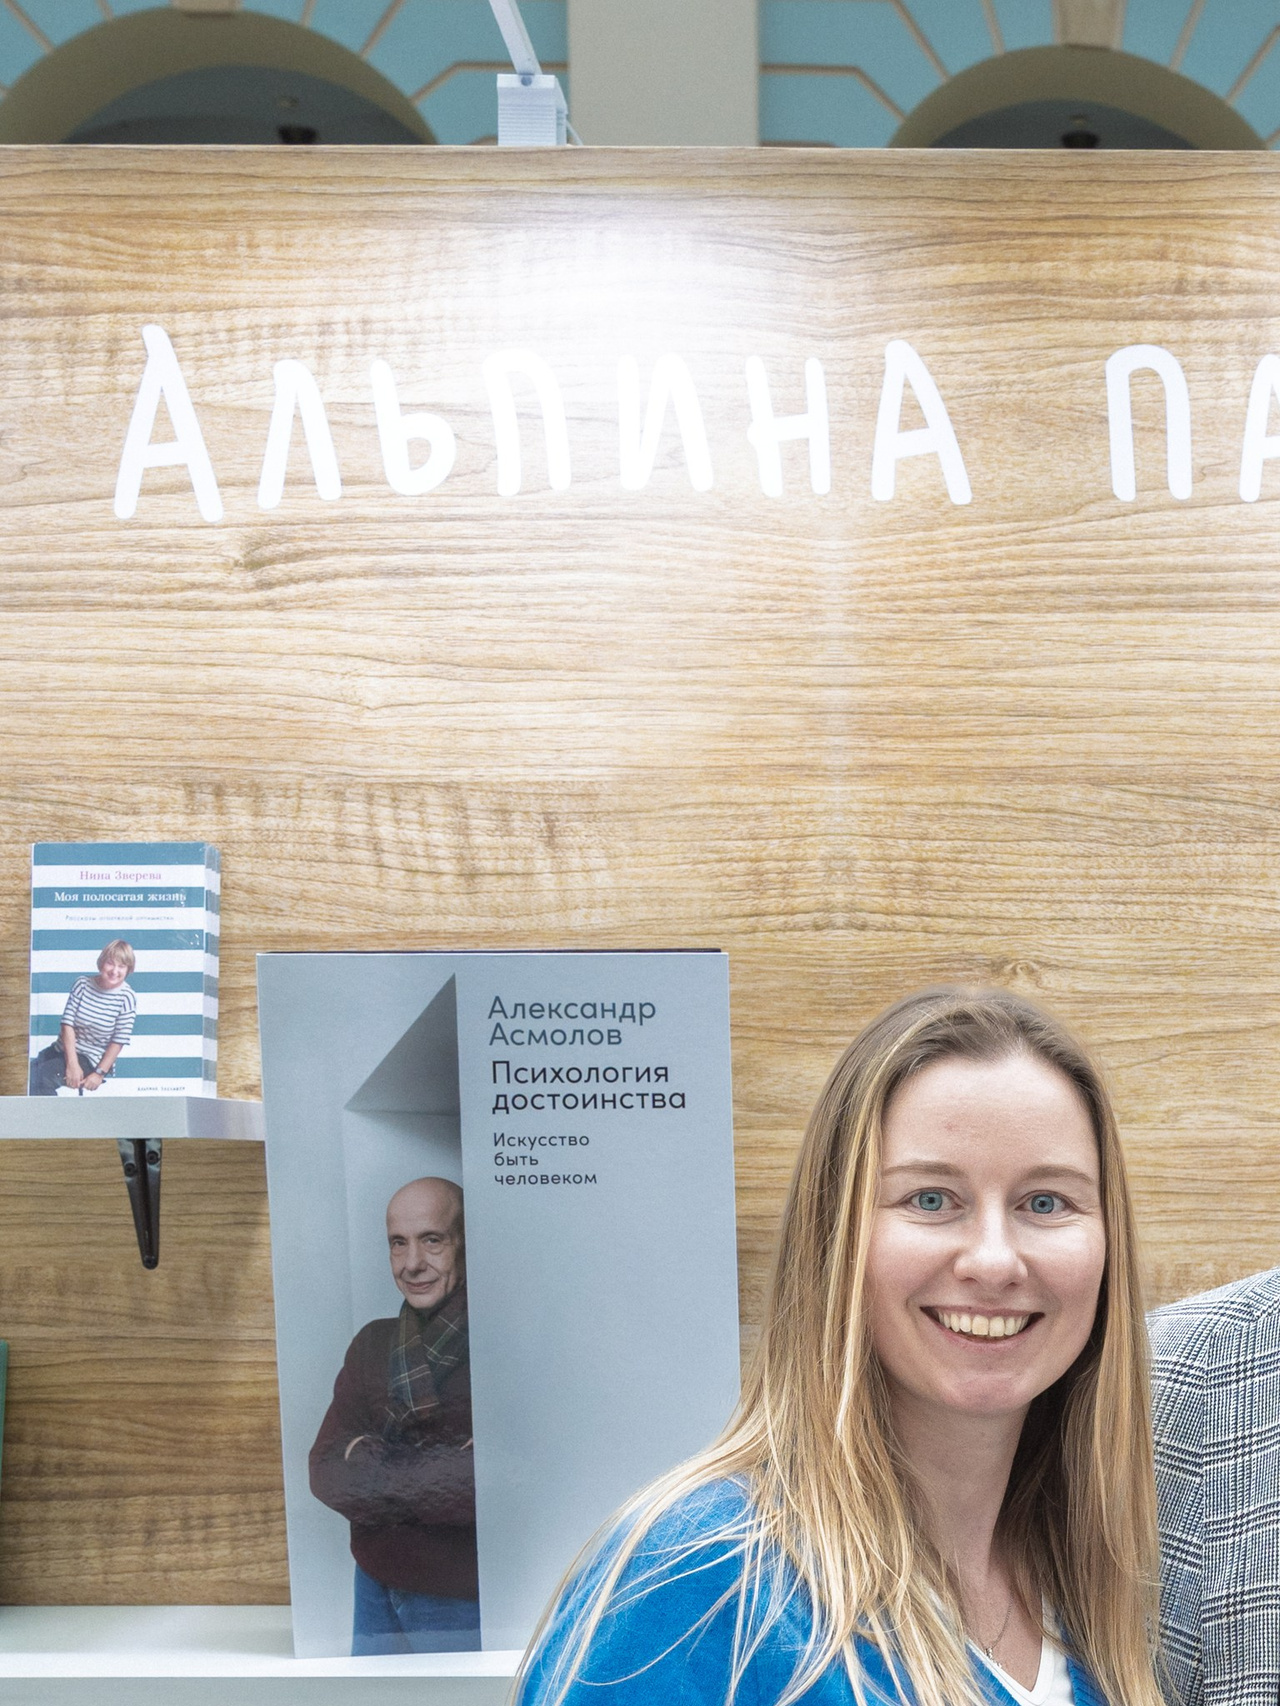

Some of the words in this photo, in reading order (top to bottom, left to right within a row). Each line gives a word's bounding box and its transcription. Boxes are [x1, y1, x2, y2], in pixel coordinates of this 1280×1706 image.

[80, 871, 111, 881] Нина
[115, 870, 162, 882] Зверева
[54, 892, 79, 902] Моя
[83, 892, 144, 902] полосатая
[488, 995, 656, 1025] Александр
[489, 1022, 623, 1046] Асмолов
[492, 1060, 669, 1084] Психология
[492, 1091, 686, 1115] достоинства
[493, 1132, 590, 1150] Искусство
[494, 1152, 539, 1167] быть
[494, 1172, 597, 1185] человеком
